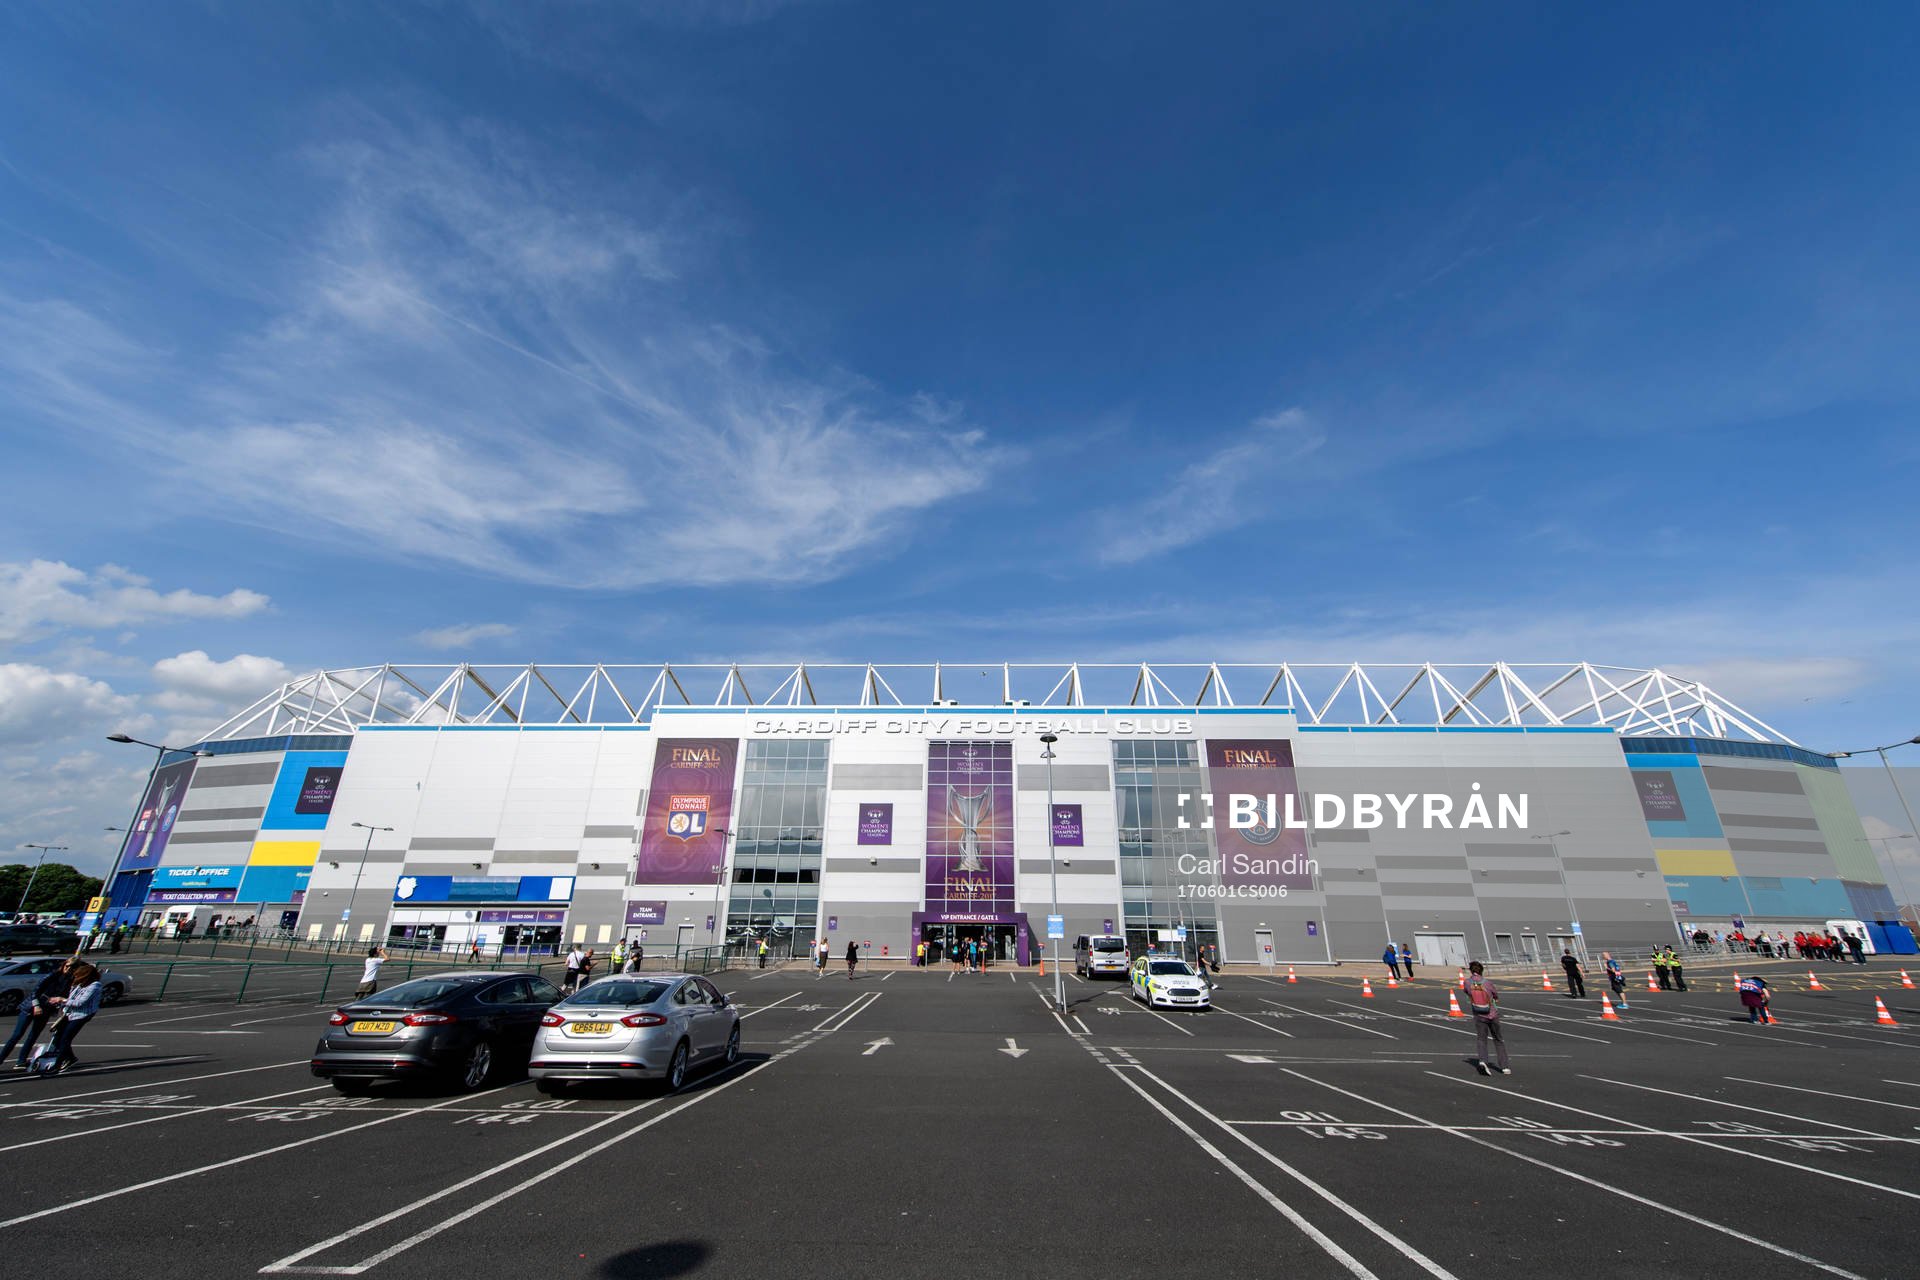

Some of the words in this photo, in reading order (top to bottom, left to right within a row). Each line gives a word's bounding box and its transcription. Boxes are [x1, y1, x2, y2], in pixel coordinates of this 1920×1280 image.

[753, 718, 877, 734] CARDIFF
[885, 718, 949, 734] CITY
[956, 718, 1108, 734] FOOTBALL
[1115, 718, 1193, 734] CLUB
[672, 748, 720, 761] FINAL
[1223, 749, 1277, 763] FINAL
[168, 868, 197, 876] TICKET
[198, 868, 230, 876] OFFICE
[944, 877, 996, 892] FINAL
[92, 900, 99, 909] D
[1295, 1125, 1389, 1140] 145
[1525, 1132, 1627, 1146] 146
